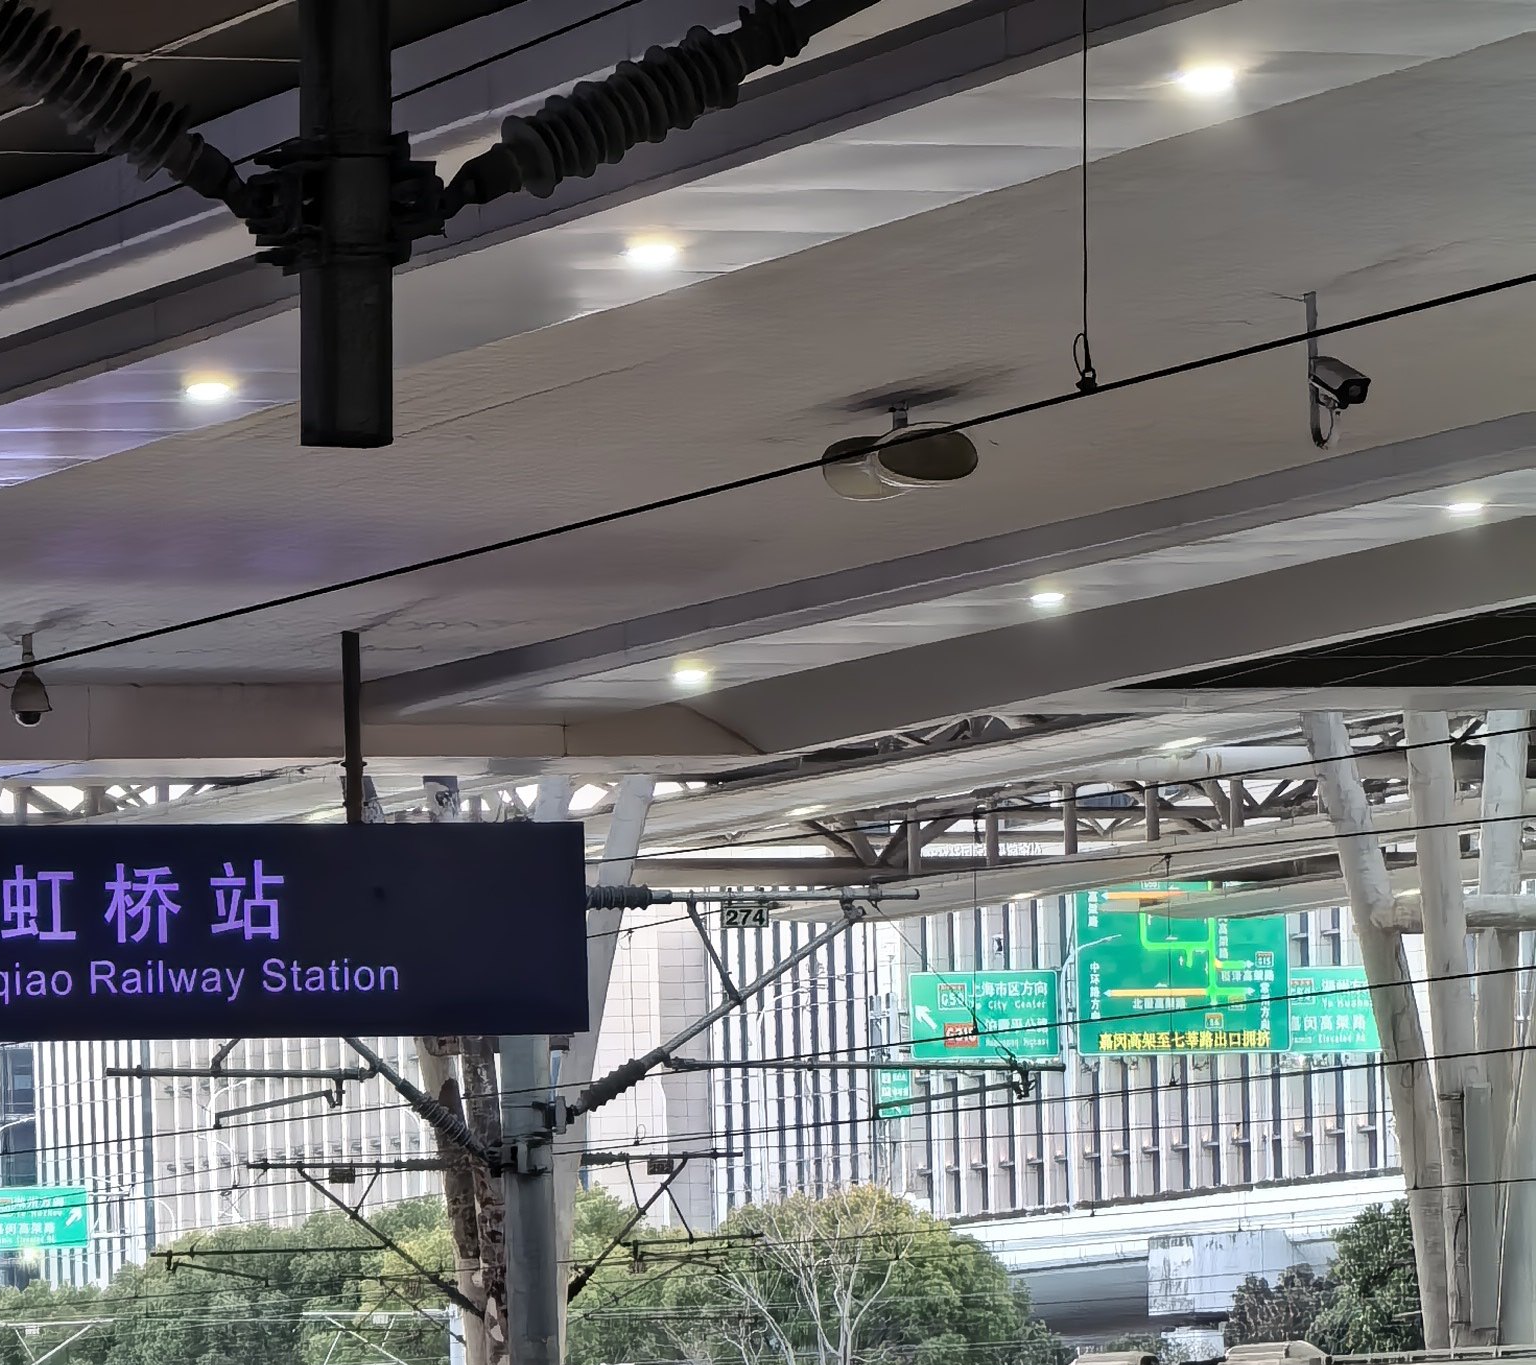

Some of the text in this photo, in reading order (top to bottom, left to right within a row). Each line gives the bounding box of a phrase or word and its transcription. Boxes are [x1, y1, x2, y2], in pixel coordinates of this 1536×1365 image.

[726, 909, 766, 926] 274
[89, 959, 245, 1002] Railway
[262, 957, 399, 993] Station
[968, 980, 1048, 997] 上海市区方向
